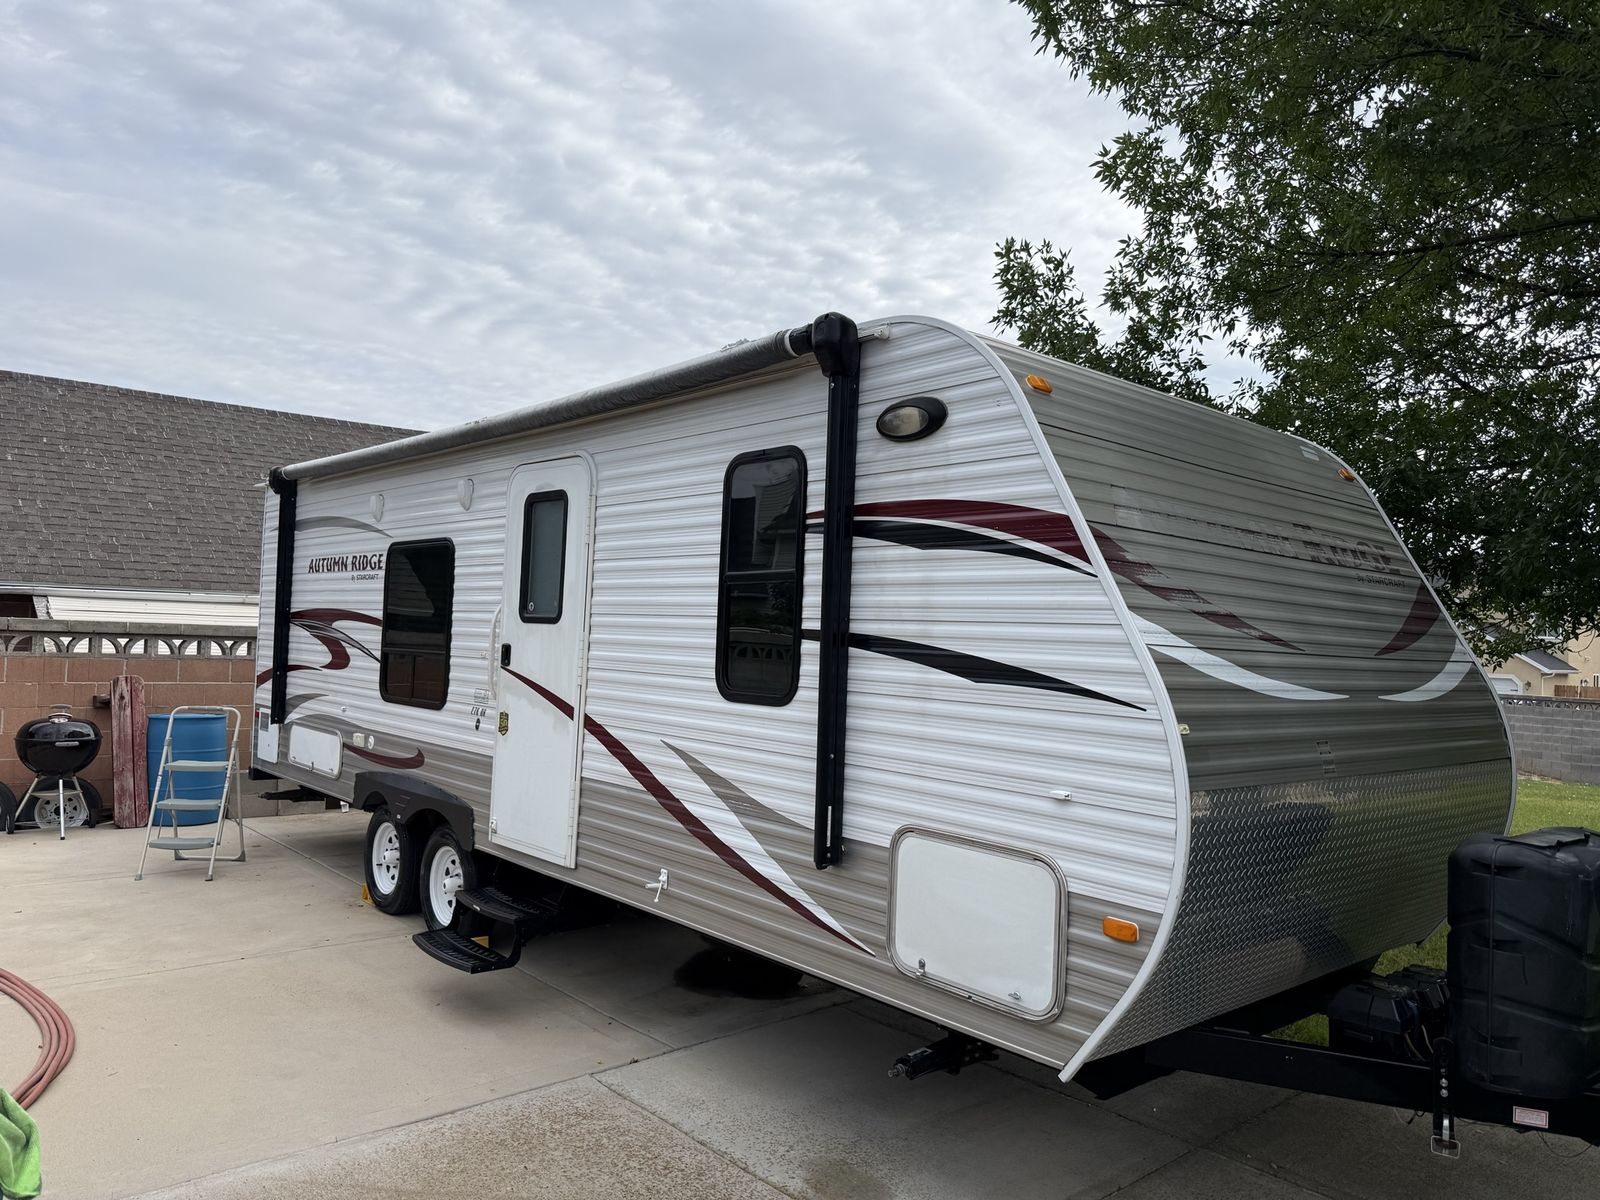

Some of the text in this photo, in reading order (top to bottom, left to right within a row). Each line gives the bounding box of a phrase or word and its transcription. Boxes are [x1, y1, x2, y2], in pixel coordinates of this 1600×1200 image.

[308, 554, 384, 573] AUTUMN RIDGE
[356, 573, 379, 581] STARCRAFT
[1366, 574, 1406, 588] STARCRAFT
